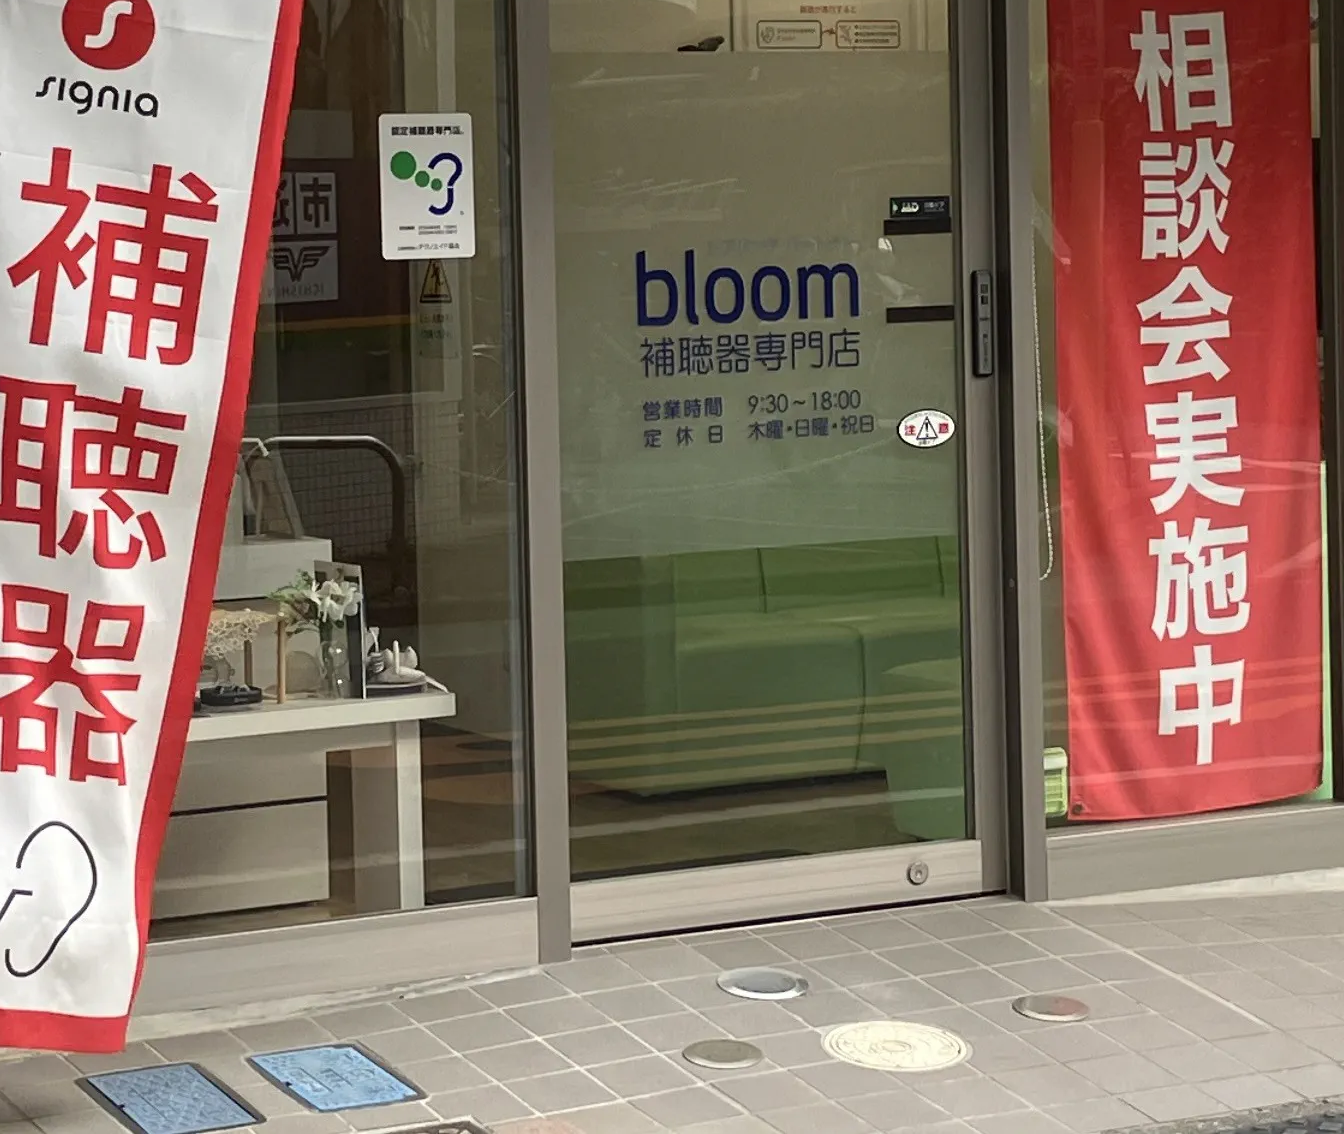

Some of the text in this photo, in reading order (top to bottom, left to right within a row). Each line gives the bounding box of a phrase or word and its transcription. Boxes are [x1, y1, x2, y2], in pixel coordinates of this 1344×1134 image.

[35, 76, 159, 118] signia
[635, 249, 860, 327] bloom
[639, 327, 861, 378] 補聴器専門店
[642, 396, 723, 422] 営業時間
[1130, 9, 1252, 767] 相談会実施中
